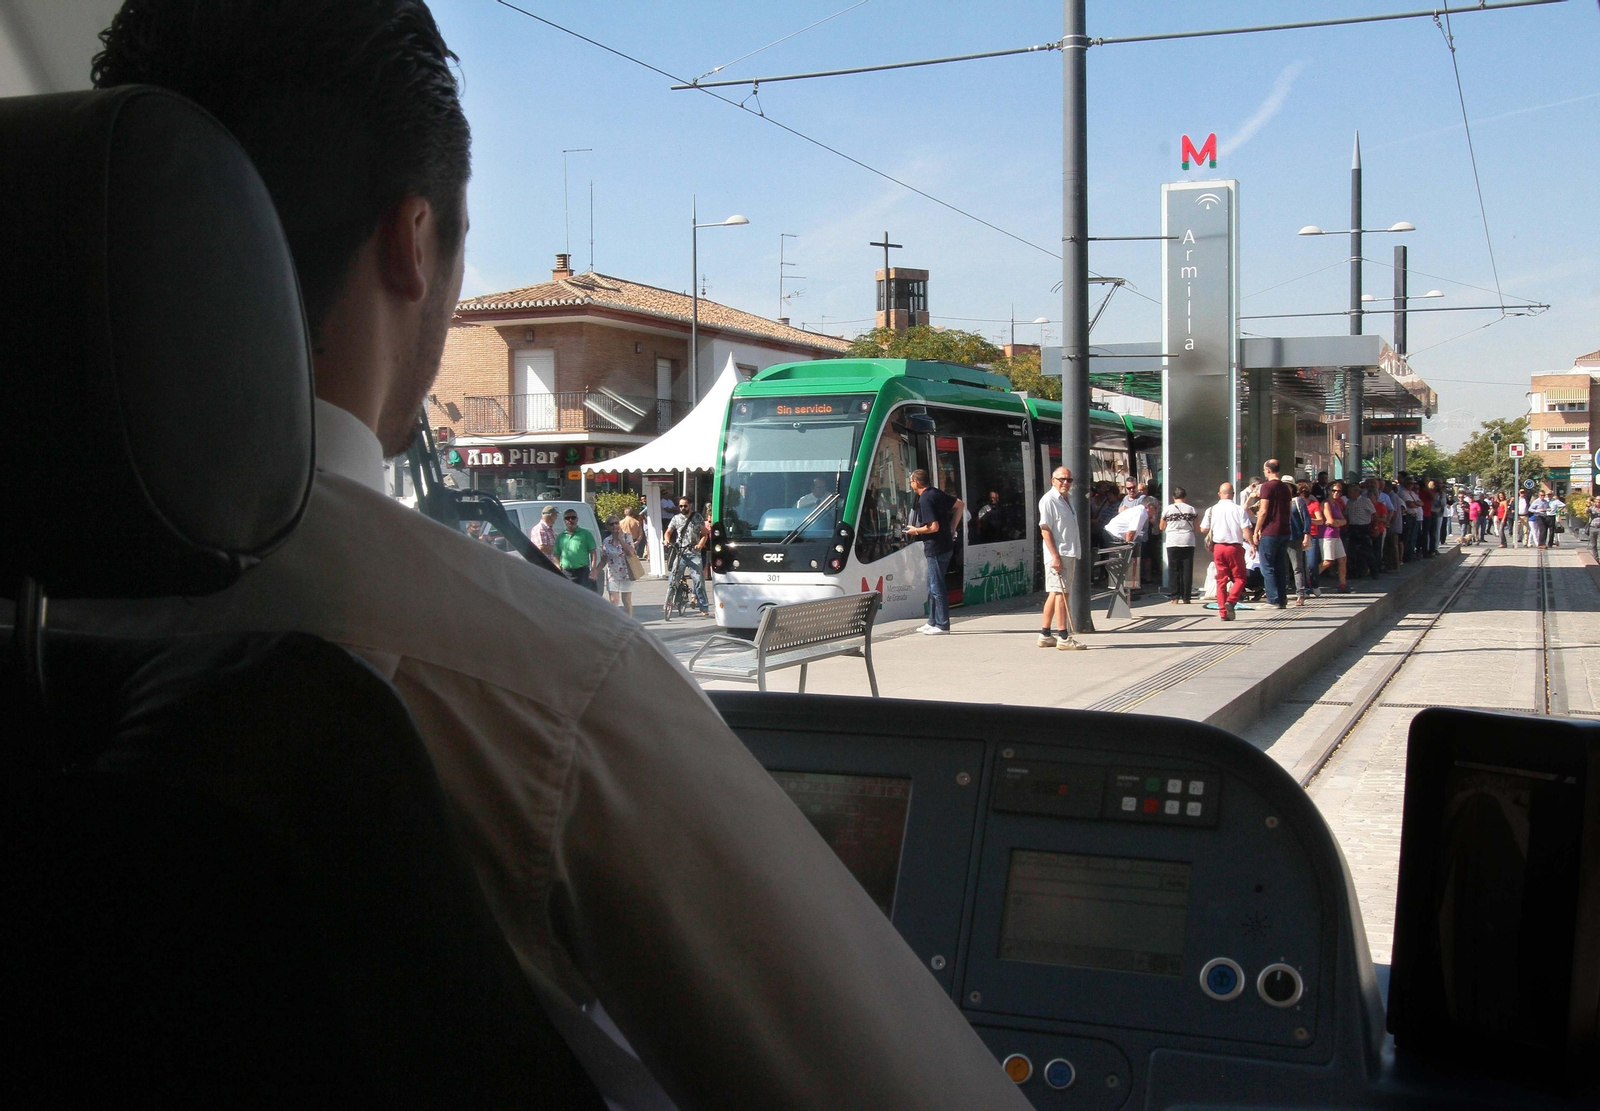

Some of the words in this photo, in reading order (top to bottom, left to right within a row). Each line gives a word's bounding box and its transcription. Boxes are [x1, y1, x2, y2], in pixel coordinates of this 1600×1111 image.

[1180, 229, 1197, 351] Armilla
[776, 405, 792, 414] Sin
[795, 403, 832, 414] servicio
[467, 449, 505, 466] Ana
[508, 448, 559, 465] Pilar
[763, 553, 785, 563] CAF
[766, 574, 781, 582] 301
